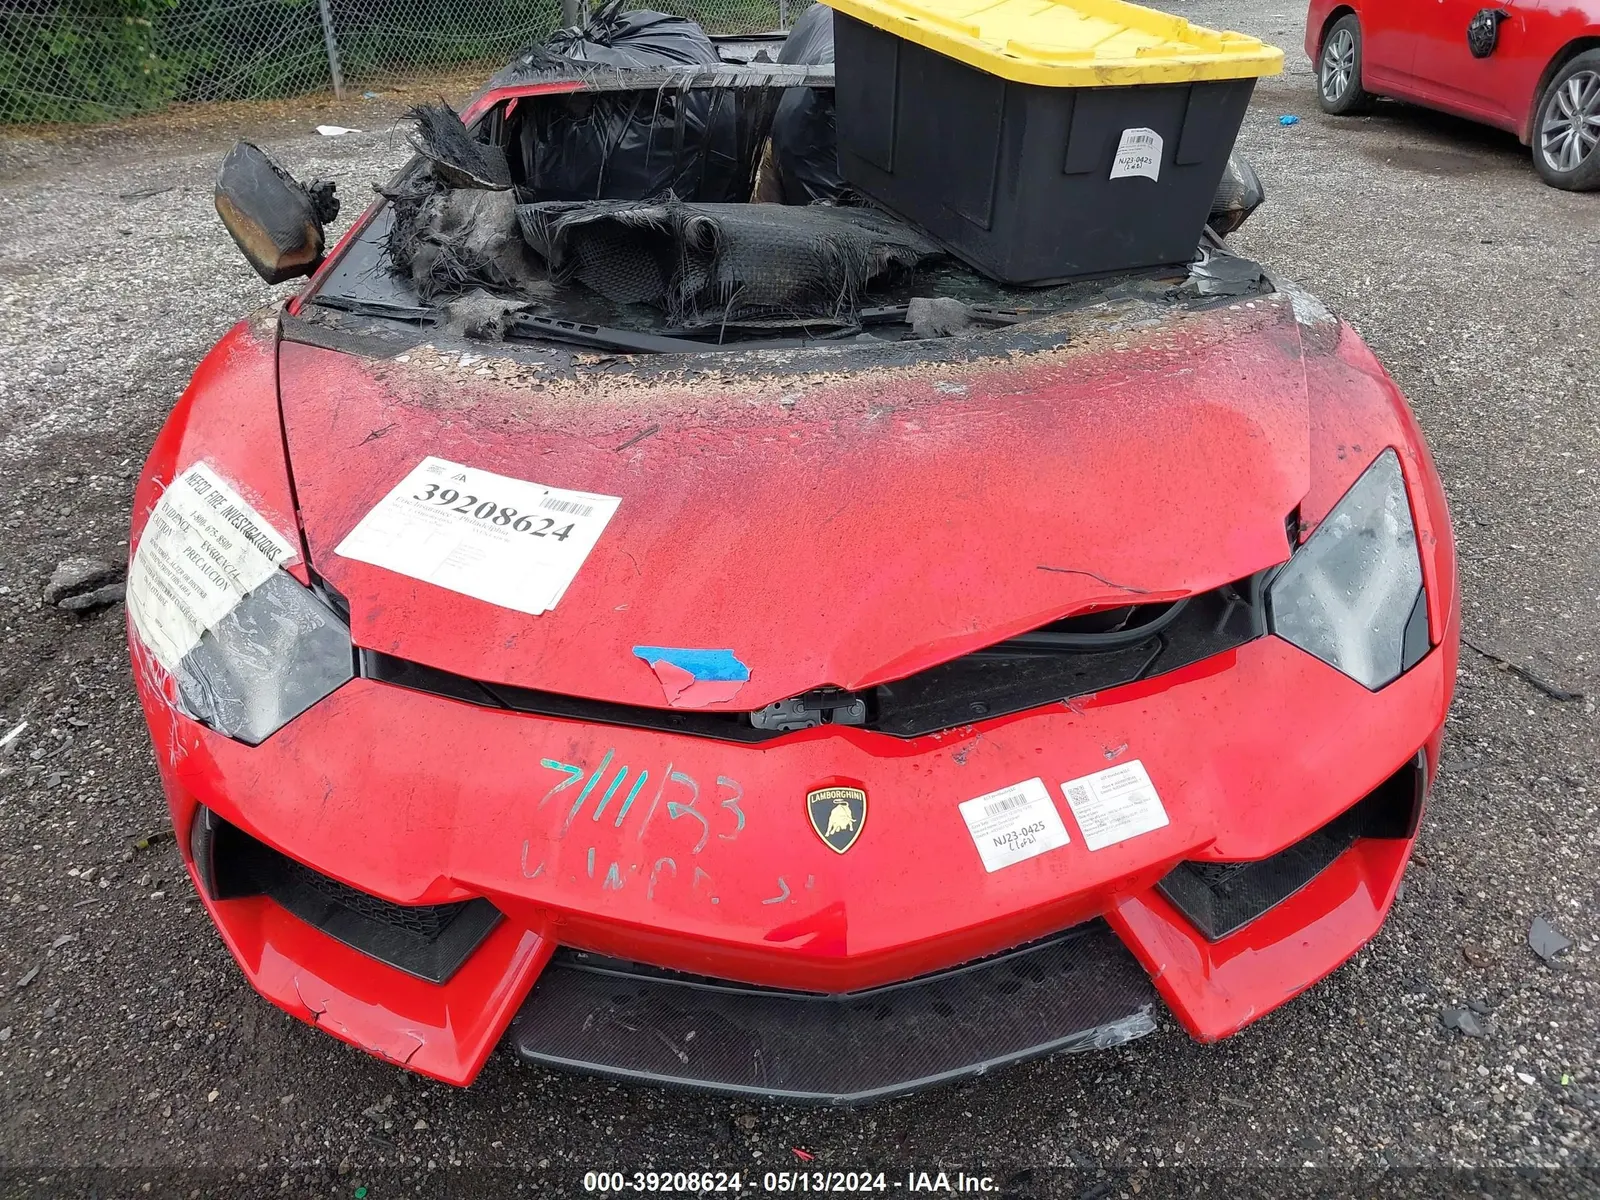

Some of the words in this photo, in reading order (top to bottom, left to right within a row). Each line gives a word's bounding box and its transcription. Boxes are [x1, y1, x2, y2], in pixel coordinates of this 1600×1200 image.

[152, 513, 172, 537] CAUTION
[161, 502, 191, 533] EVIDENCE
[185, 472, 212, 495] NEFCO
[204, 490, 227, 509] FIRE
[220, 505, 282, 561] INVESTIGATIONS
[413, 484, 576, 542] 39208624
[414, 501, 452, 518] Insurance
[459, 515, 509, 537] Philadelphia
[216, 535, 233, 550] 8500
[182, 546, 231, 591] PRECAUCION
[811, 790, 862, 803] LAMBORGHINI
[993, 821, 1046, 847] NJ23-0425
